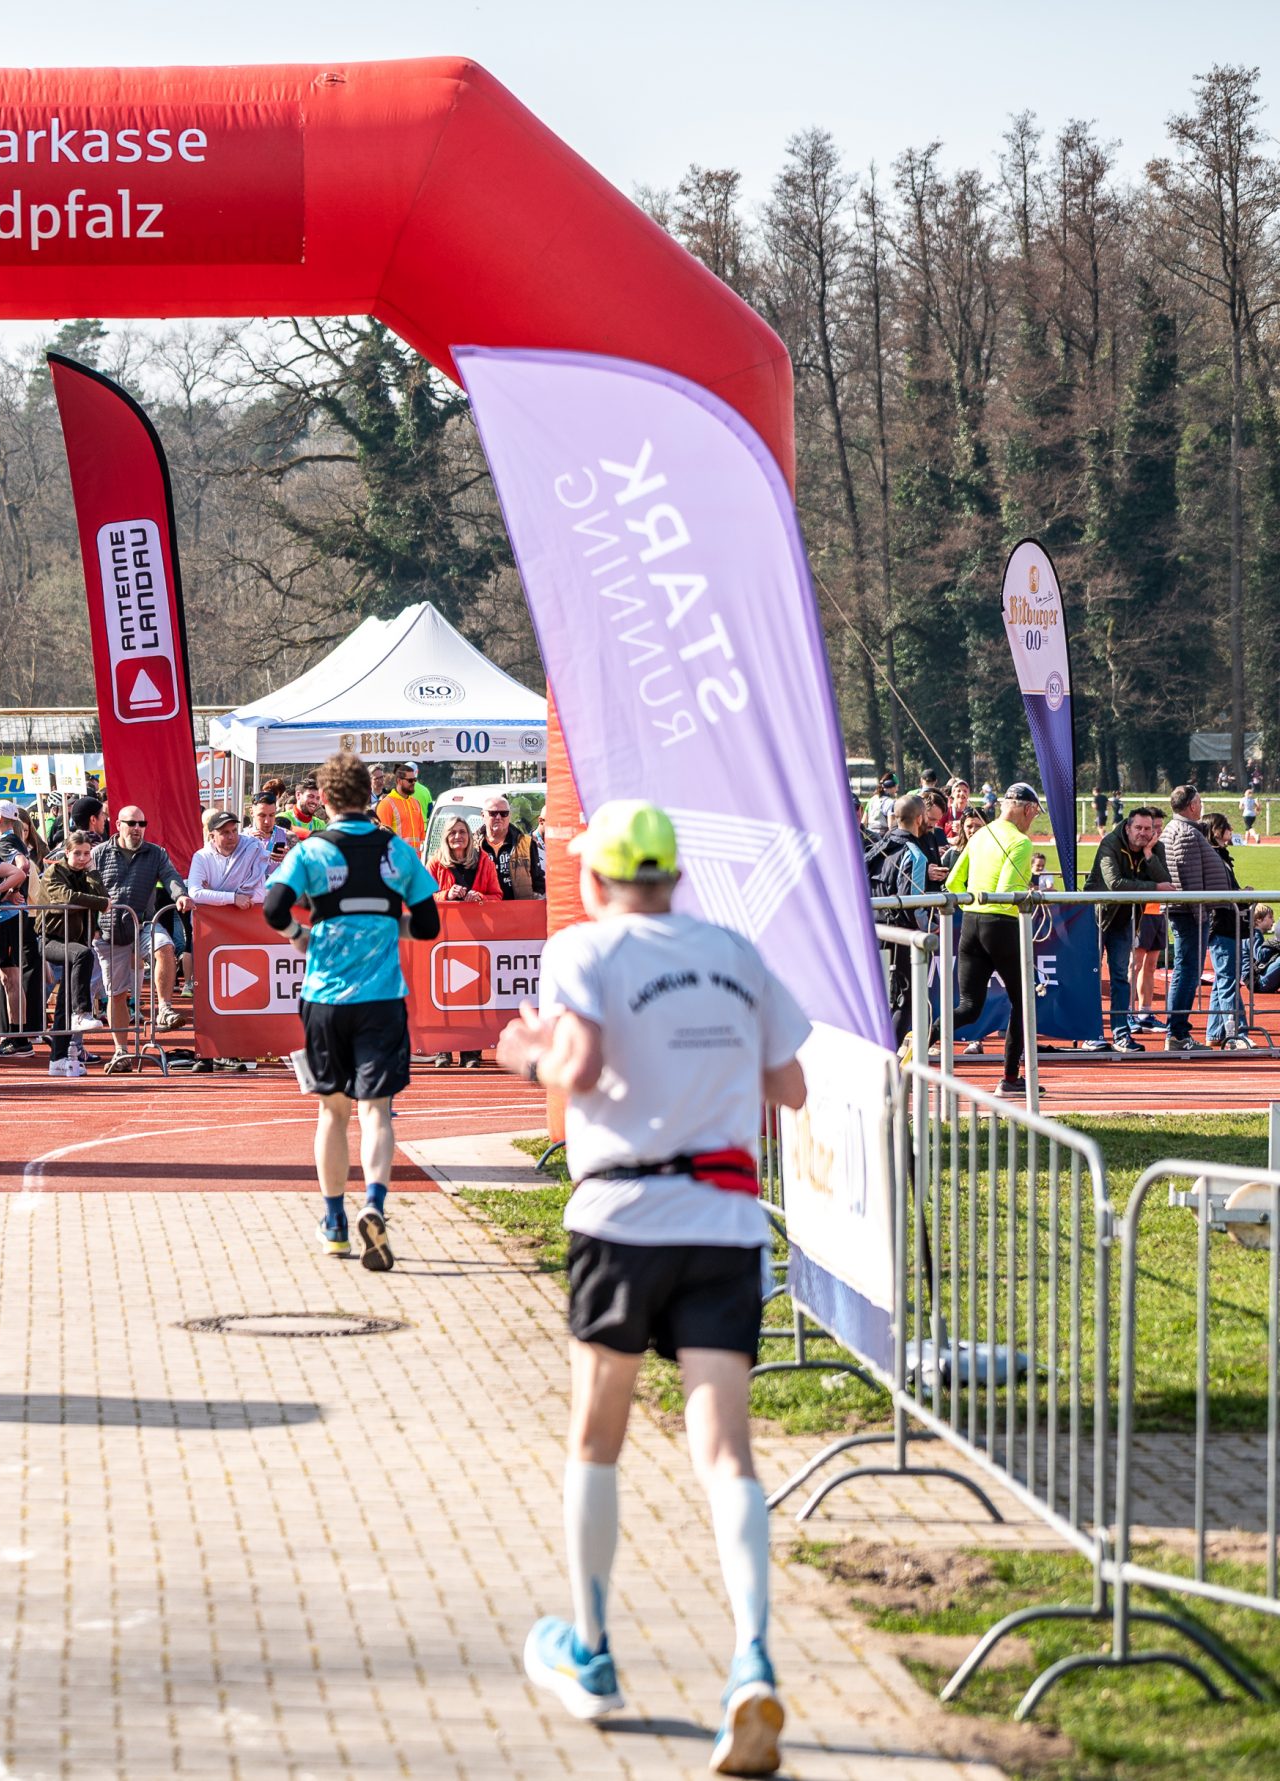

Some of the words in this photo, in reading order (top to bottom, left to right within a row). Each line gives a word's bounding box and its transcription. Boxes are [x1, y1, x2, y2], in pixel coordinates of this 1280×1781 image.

[109, 529, 137, 651] ANTENNE
[129, 527, 160, 649] LANDAU
[1008, 594, 1058, 630] Bitburger
[419, 685, 452, 696] ISO
[1049, 681, 1060, 694] ISO
[360, 732, 435, 757] Bitburger
[455, 730, 490, 754] 0.0
[524, 737, 539, 746] ISO
